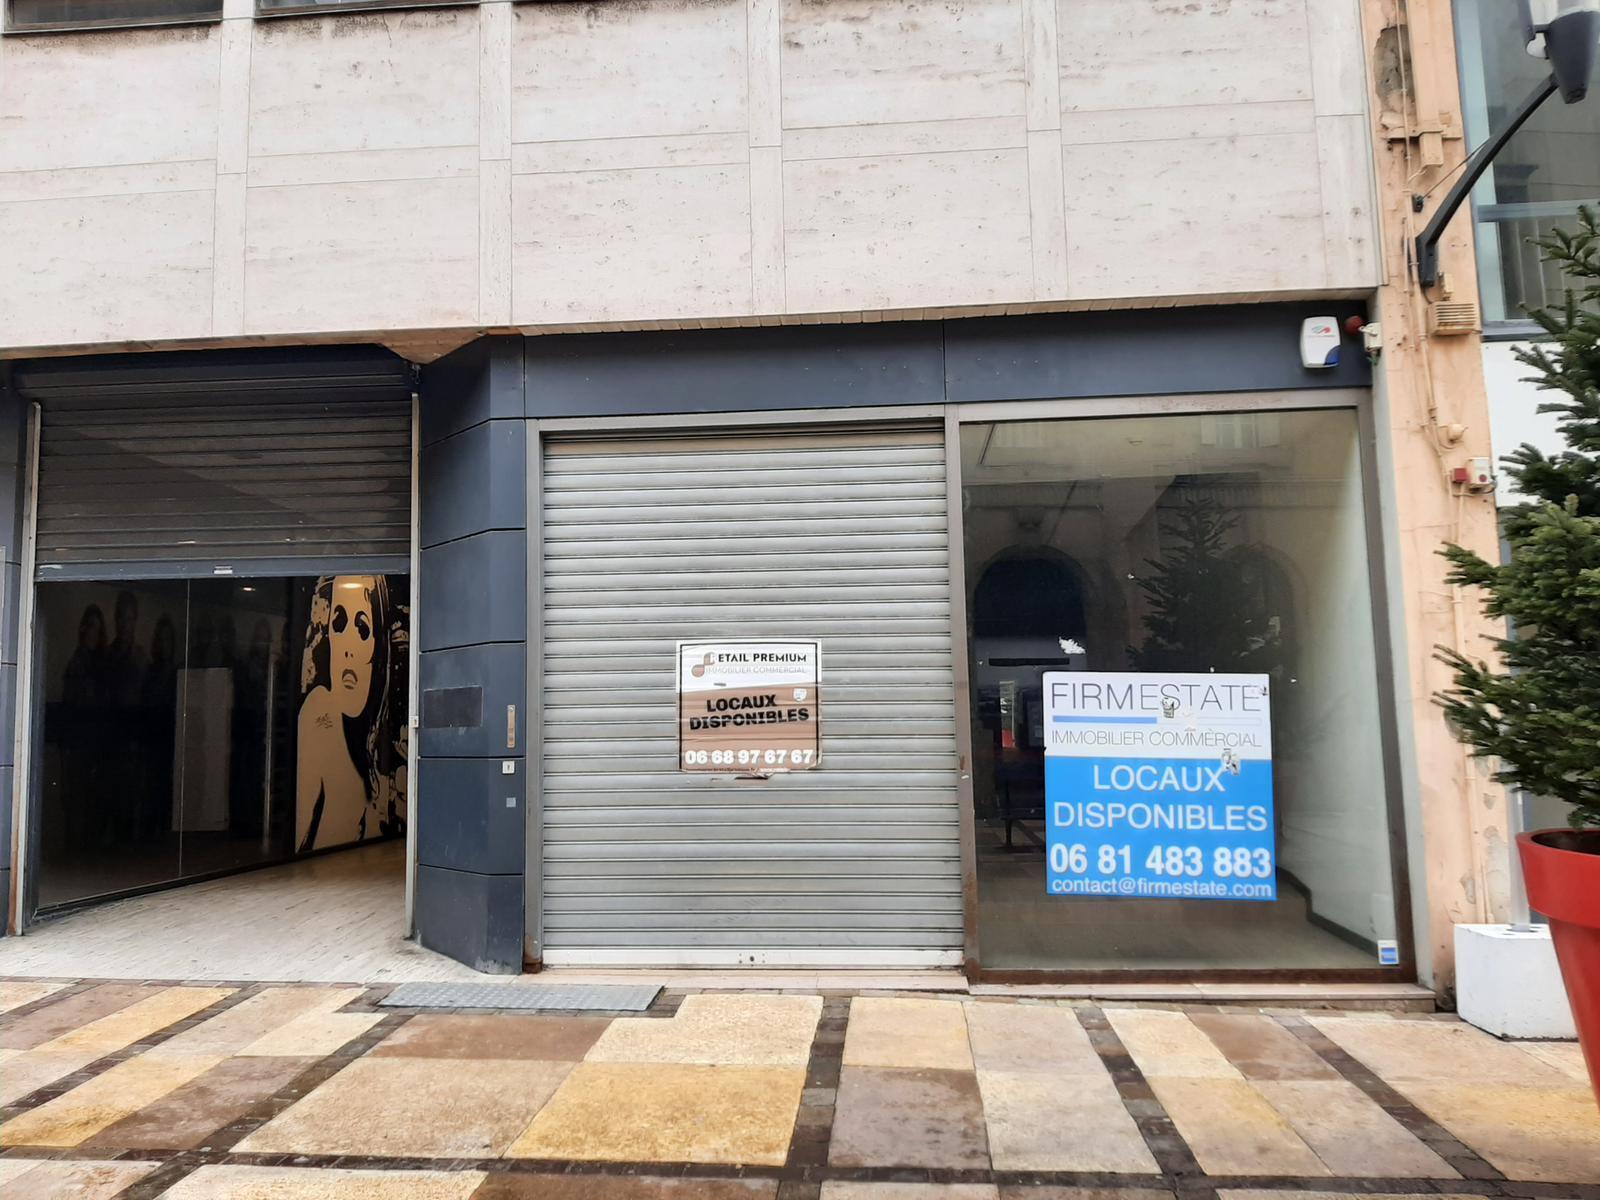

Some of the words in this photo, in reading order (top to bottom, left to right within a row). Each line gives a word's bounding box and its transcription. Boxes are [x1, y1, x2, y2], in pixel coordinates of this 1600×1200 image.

[753, 653, 807, 662] PREMIUM
[706, 694, 777, 713] LOCAUX
[1051, 682, 1261, 712] FIRMESTATE
[689, 708, 809, 731] DISPONIBLES
[1051, 730, 1144, 746] IMMOBILIER
[1149, 730, 1262, 748] COMMERCIAL
[685, 749, 708, 765] 06
[711, 749, 734, 765] 68
[738, 749, 761, 765] 97
[764, 749, 787, 765] 67
[790, 749, 814, 765] 67
[1093, 764, 1226, 792] LOCAUX
[1053, 801, 1268, 832] DISPONIBLES
[1050, 843, 1088, 874] 06
[1098, 843, 1132, 875] 81
[1145, 844, 1203, 877] 483
[1213, 846, 1272, 878] 883
[1051, 876, 1272, 897] contact@firmestate.com
